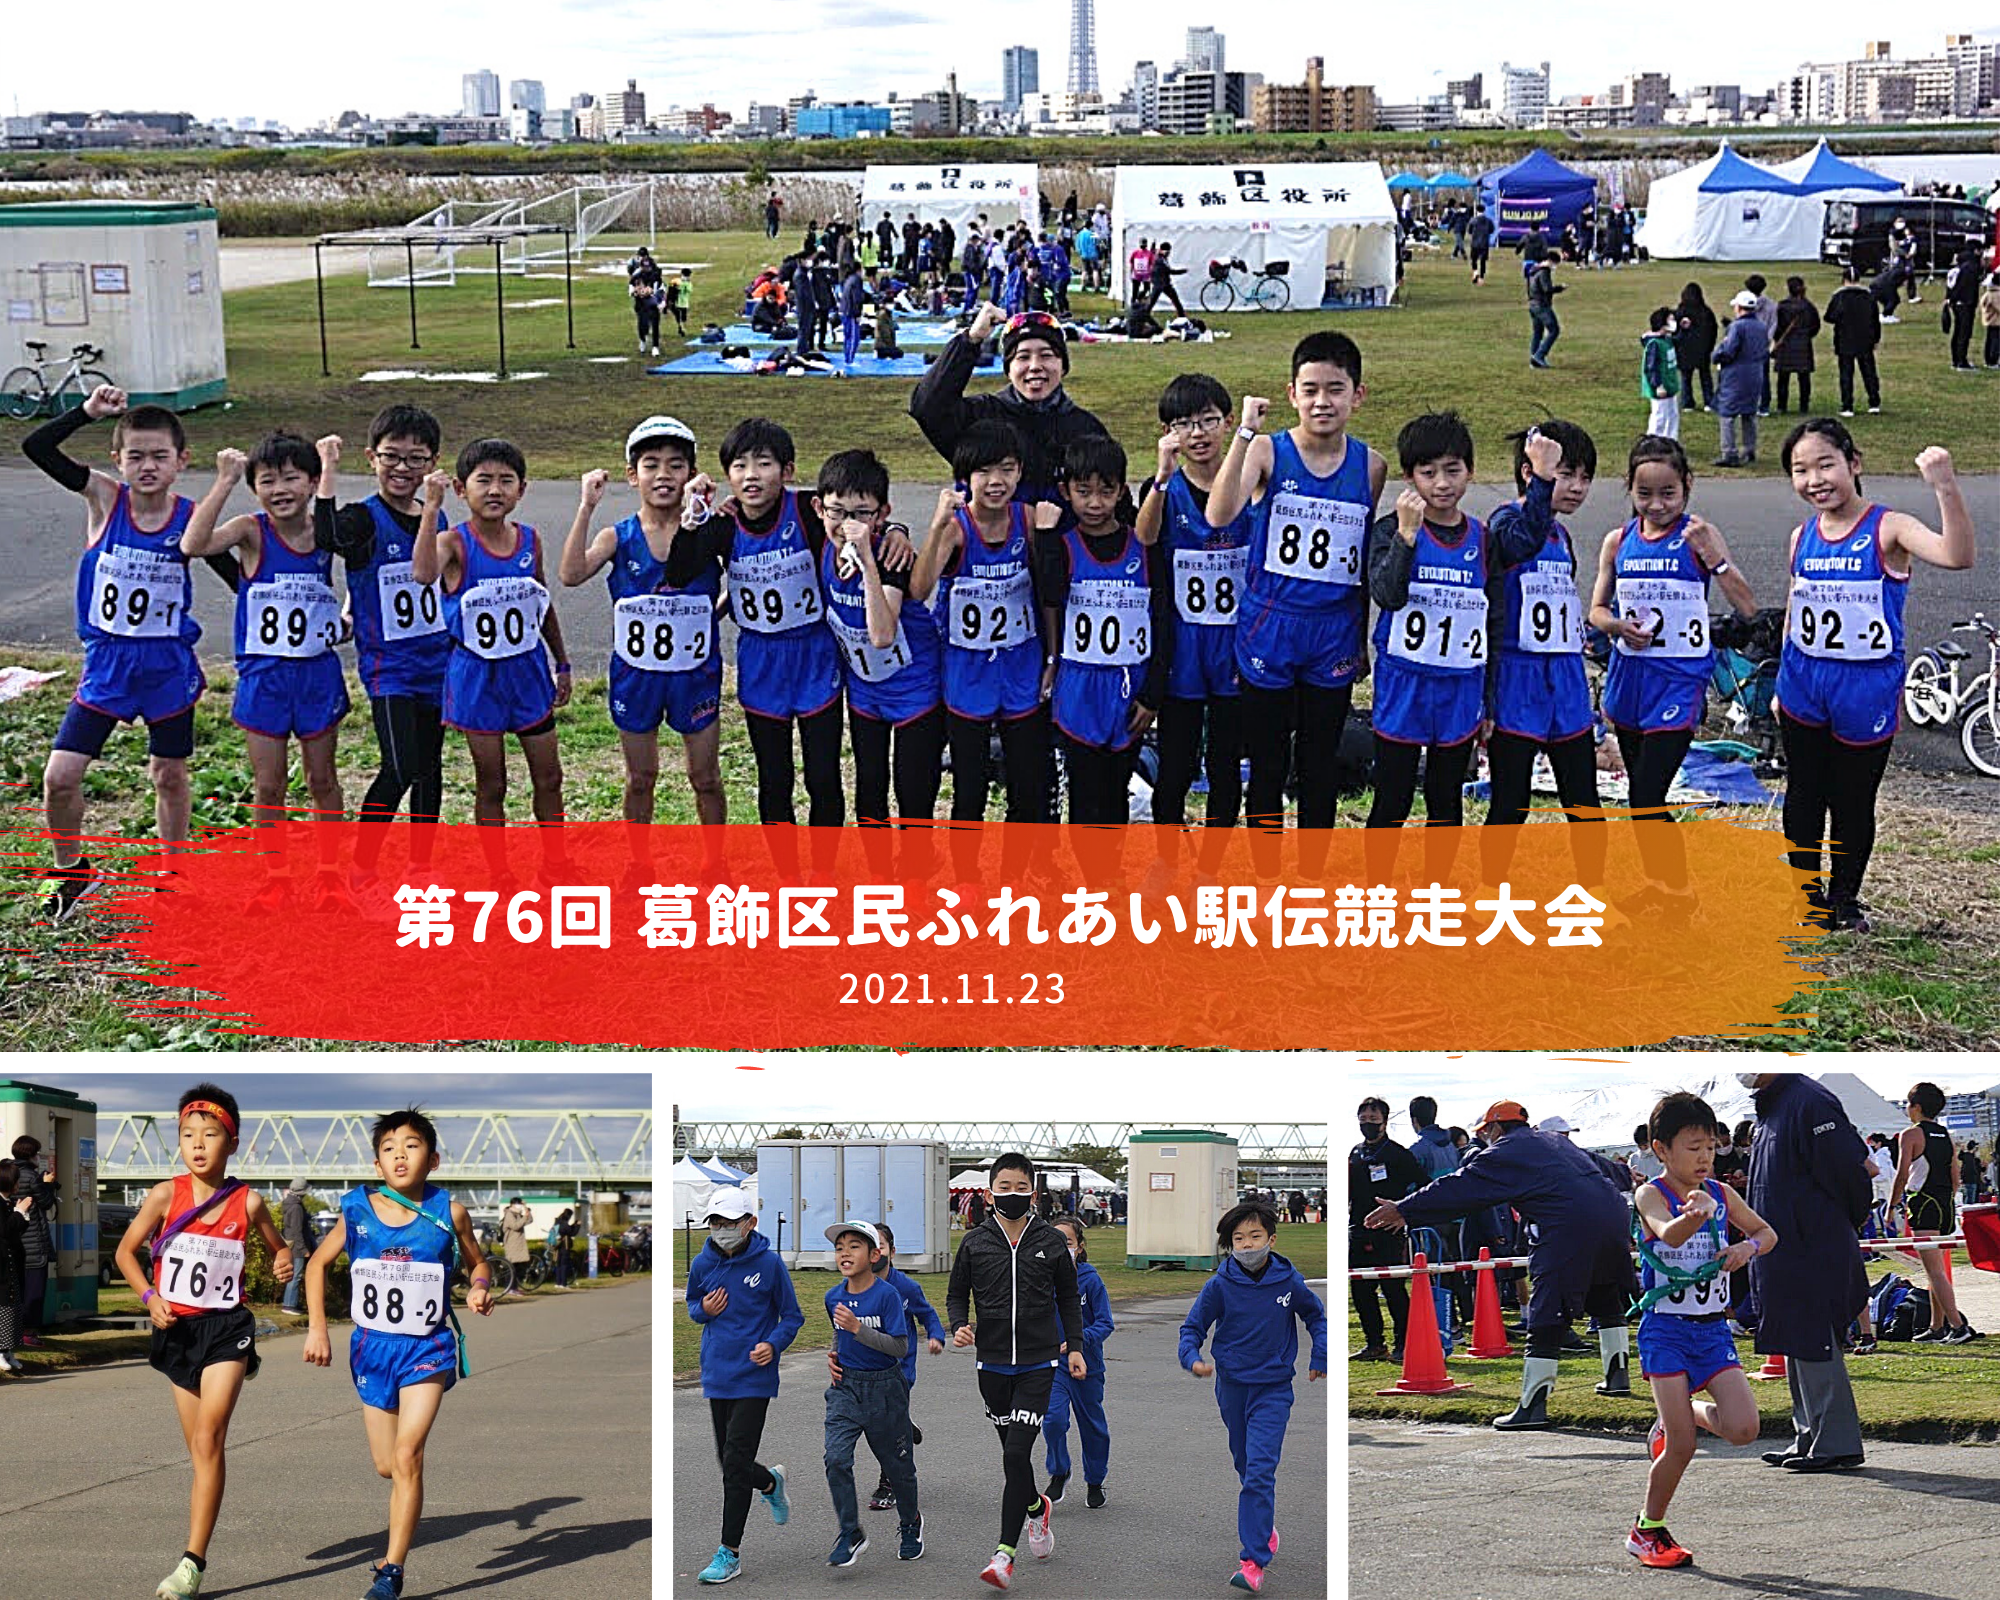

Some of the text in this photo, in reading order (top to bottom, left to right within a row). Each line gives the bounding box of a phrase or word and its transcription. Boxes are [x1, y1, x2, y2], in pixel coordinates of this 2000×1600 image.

[1158, 187, 1351, 208] 葛飾区役所
[1279, 524, 1358, 574] 88-3
[1623, 559, 1664, 571] EVOLUTION
[102, 583, 176, 627] 89-1
[394, 585, 437, 628] 90
[740, 587, 818, 624] 89-2
[1186, 576, 1235, 613] 88
[260, 606, 336, 648] 89-3
[627, 620, 705, 661] 88-2
[962, 603, 1031, 641] 92-1
[1075, 613, 1146, 656] 90-3
[1405, 611, 1482, 659] 91-2
[1802, 606, 1886, 649] 92-2
[1813, 1122, 1836, 1136] TOKYO
[188, 1237, 217, 1248] 第76回
[169, 1256, 234, 1301] 76-2
[381, 1263, 410, 1272] 第76回
[363, 1283, 438, 1326] 88-2
